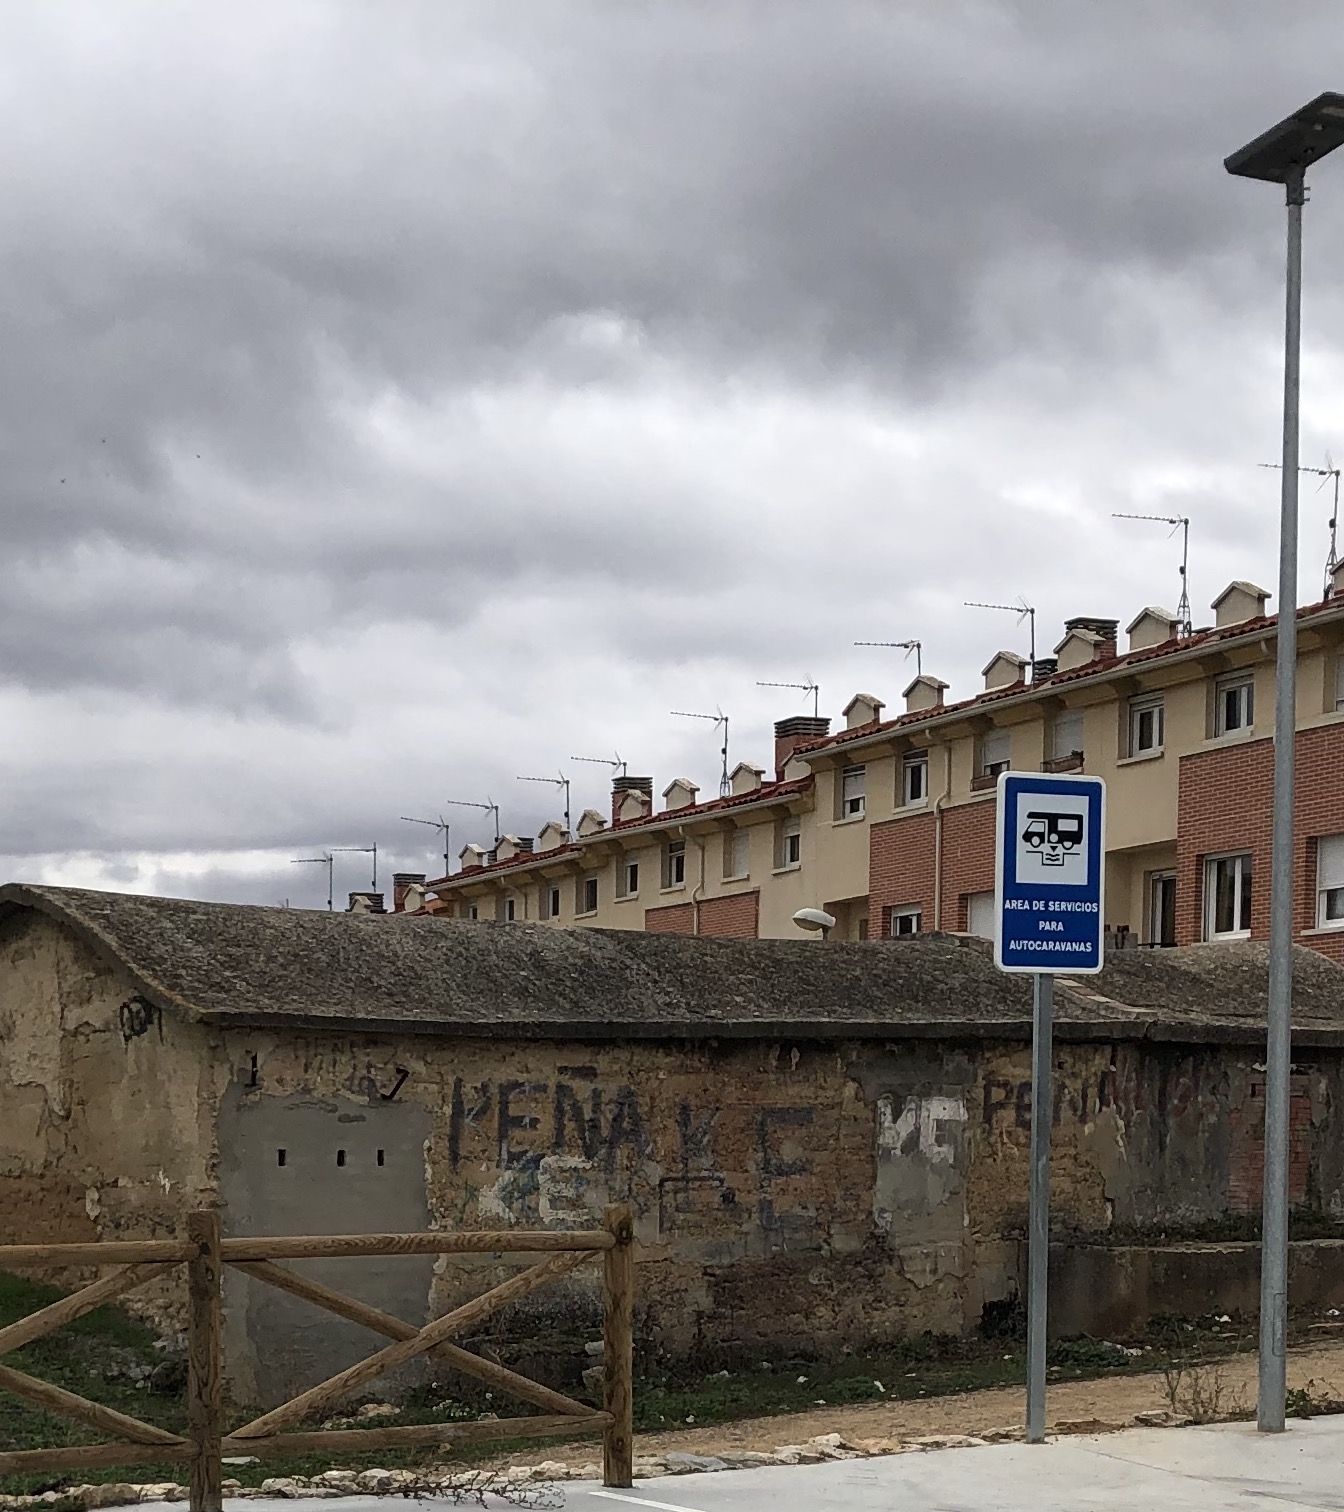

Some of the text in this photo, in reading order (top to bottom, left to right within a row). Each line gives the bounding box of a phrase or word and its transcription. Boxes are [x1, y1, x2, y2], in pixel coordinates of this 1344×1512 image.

[1004, 899, 1099, 913] AREA DE SERVICIOS
[1038, 920, 1065, 932] PARA
[1008, 939, 1093, 953] AUTOCARAVANAS
